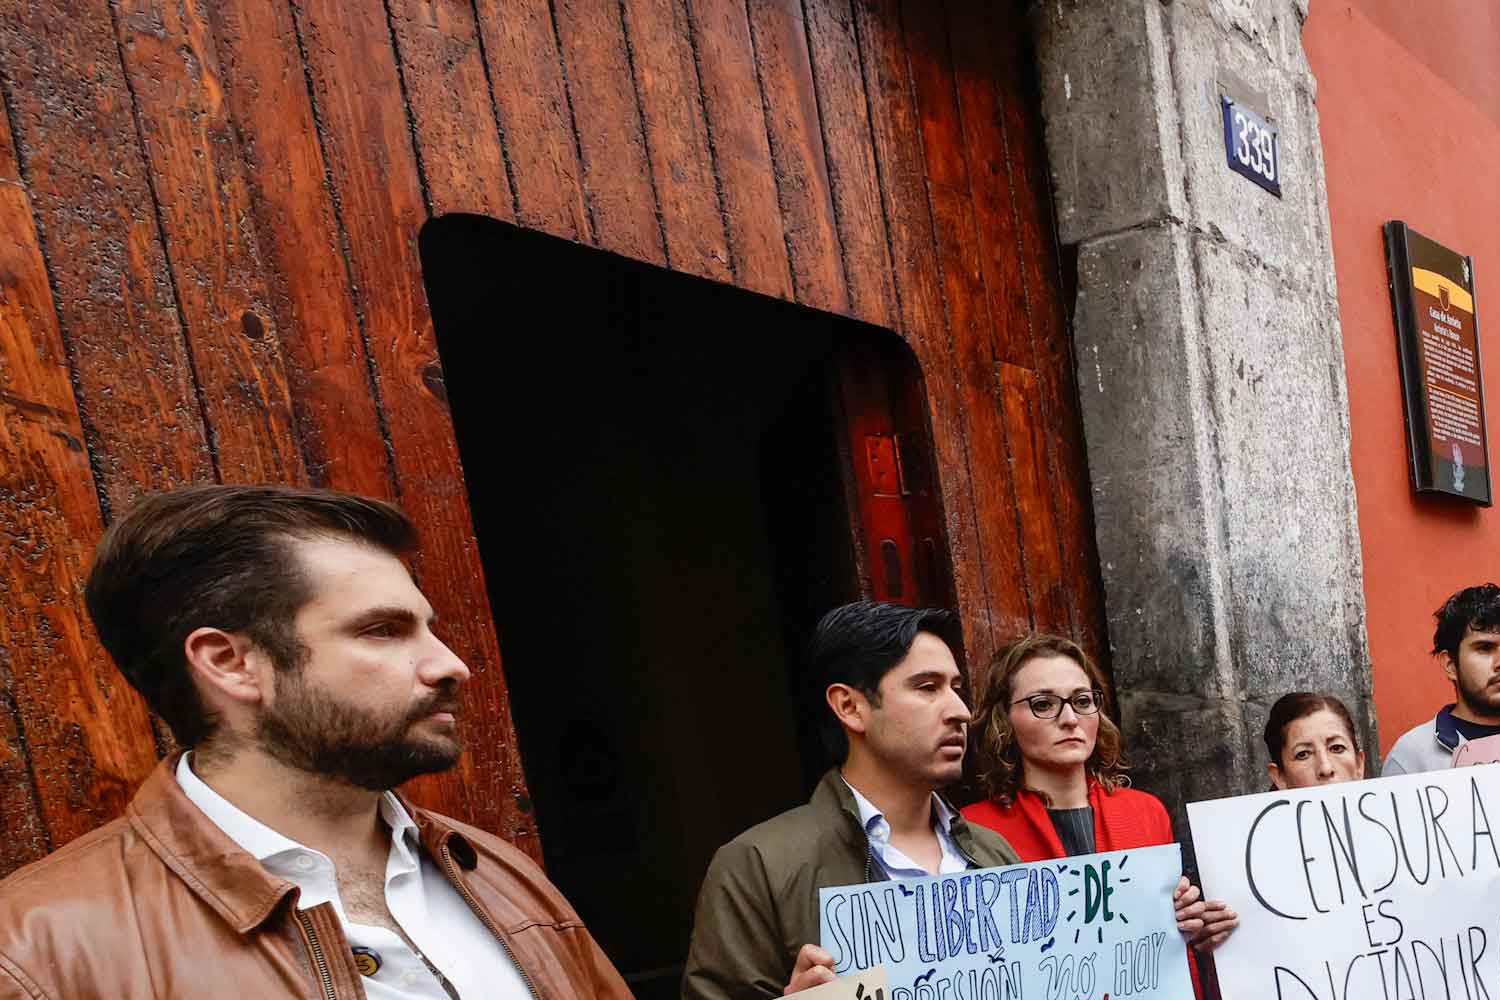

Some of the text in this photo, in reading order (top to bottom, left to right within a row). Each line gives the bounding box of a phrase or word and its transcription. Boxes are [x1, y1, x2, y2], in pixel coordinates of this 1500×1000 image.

[1235, 111, 1275, 181] 339
[1245, 776, 1500, 920] CENSURA
[825, 858, 1116, 974] SIN LIBERTAD DE
[1361, 899, 1404, 948] ES
